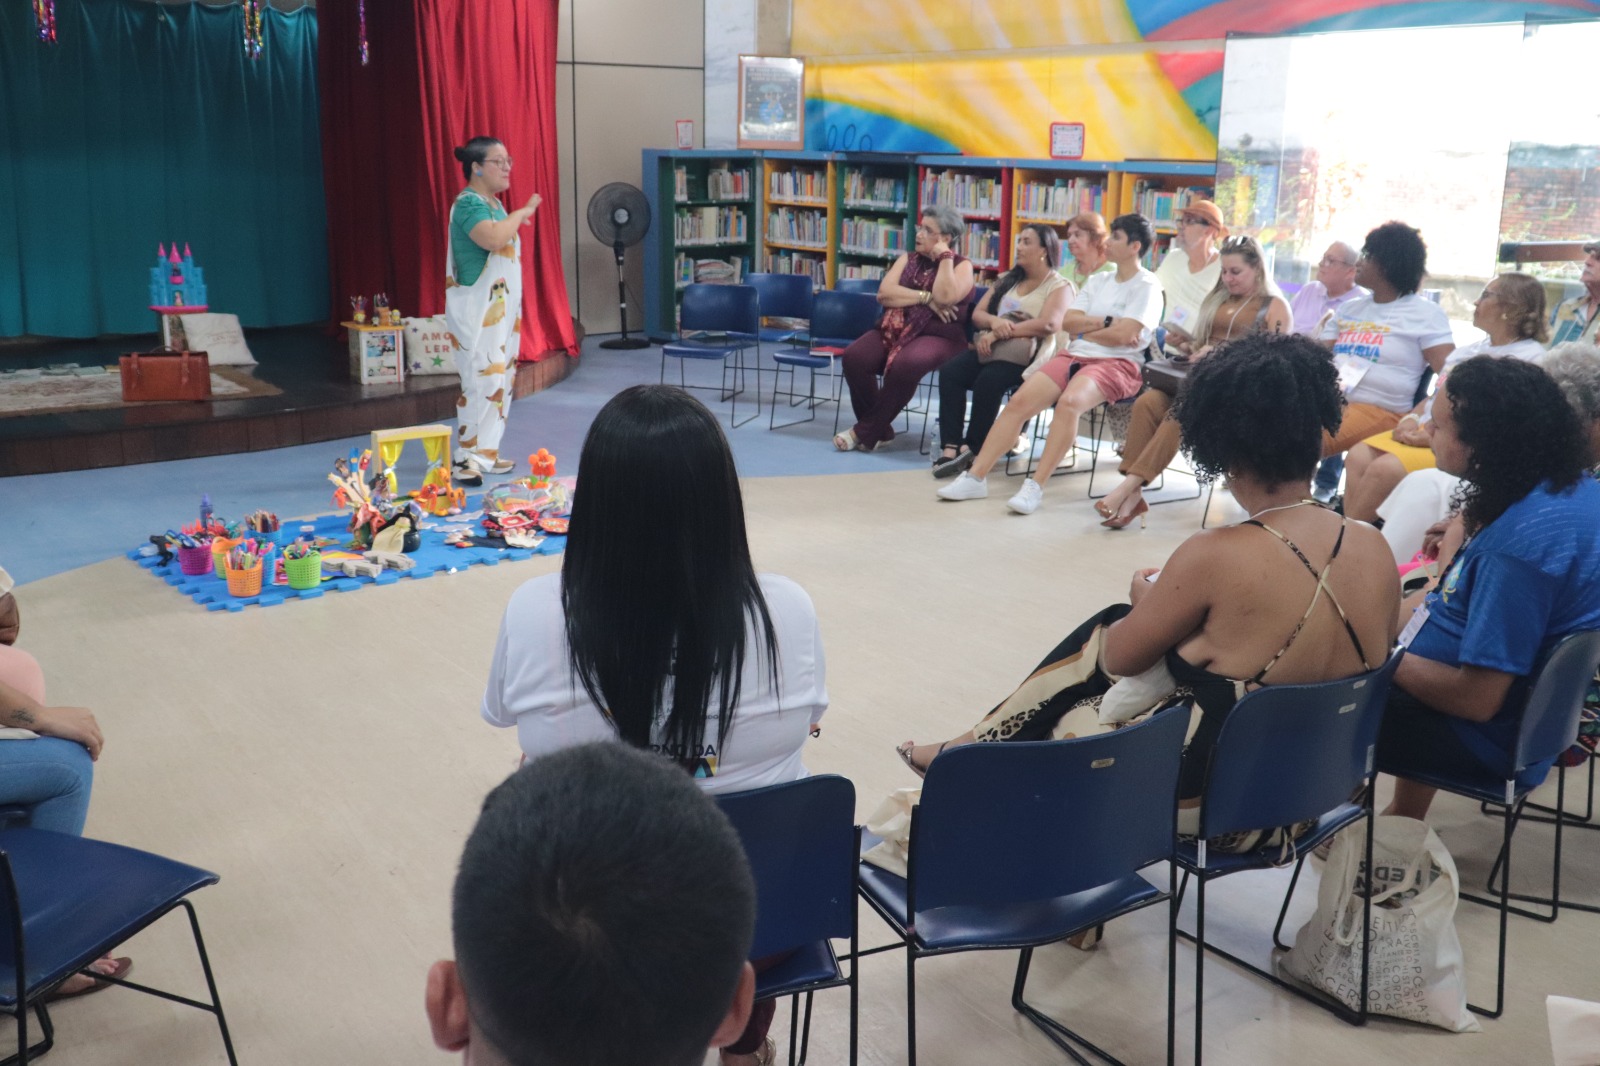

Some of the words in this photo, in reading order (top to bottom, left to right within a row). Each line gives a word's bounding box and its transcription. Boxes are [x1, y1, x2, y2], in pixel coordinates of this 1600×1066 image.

[421, 332, 451, 341] AMO
[424, 344, 450, 353] LER
[1392, 965, 1405, 1010] CORDEL
